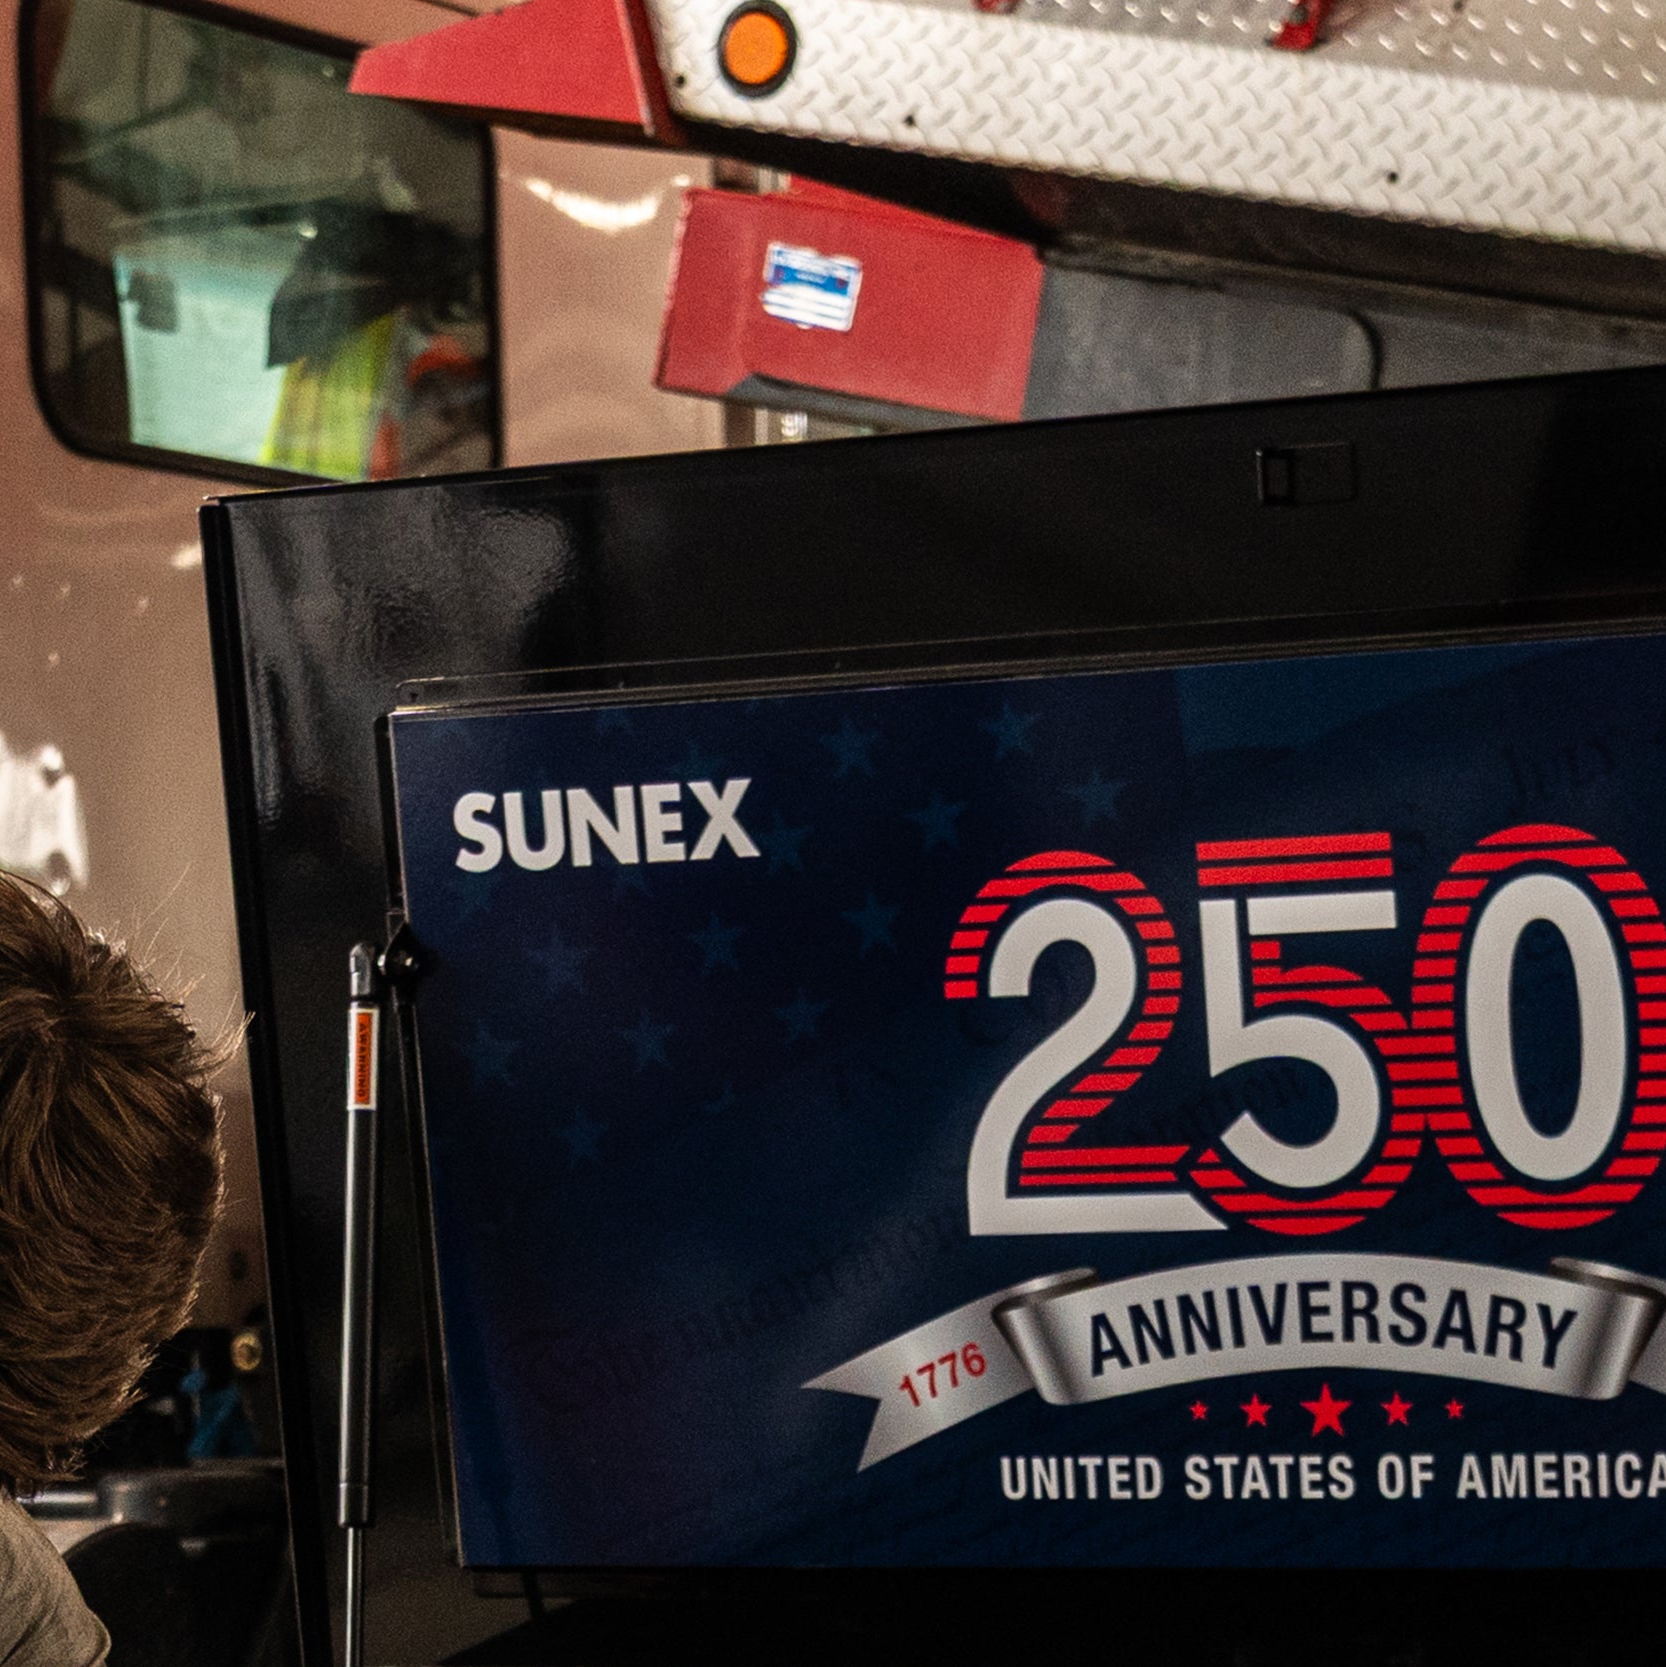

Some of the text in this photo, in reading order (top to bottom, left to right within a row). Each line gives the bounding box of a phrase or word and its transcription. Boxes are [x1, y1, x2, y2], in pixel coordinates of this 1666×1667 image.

[453, 777, 761, 874] SUNEX
[898, 1341, 989, 1410] 1776
[1088, 1279, 1580, 1378] ANNIVERSARY
[999, 1454, 1166, 1501] UNITED
[1184, 1453, 1357, 1500] STATES
[1376, 1453, 1435, 1500] OF
